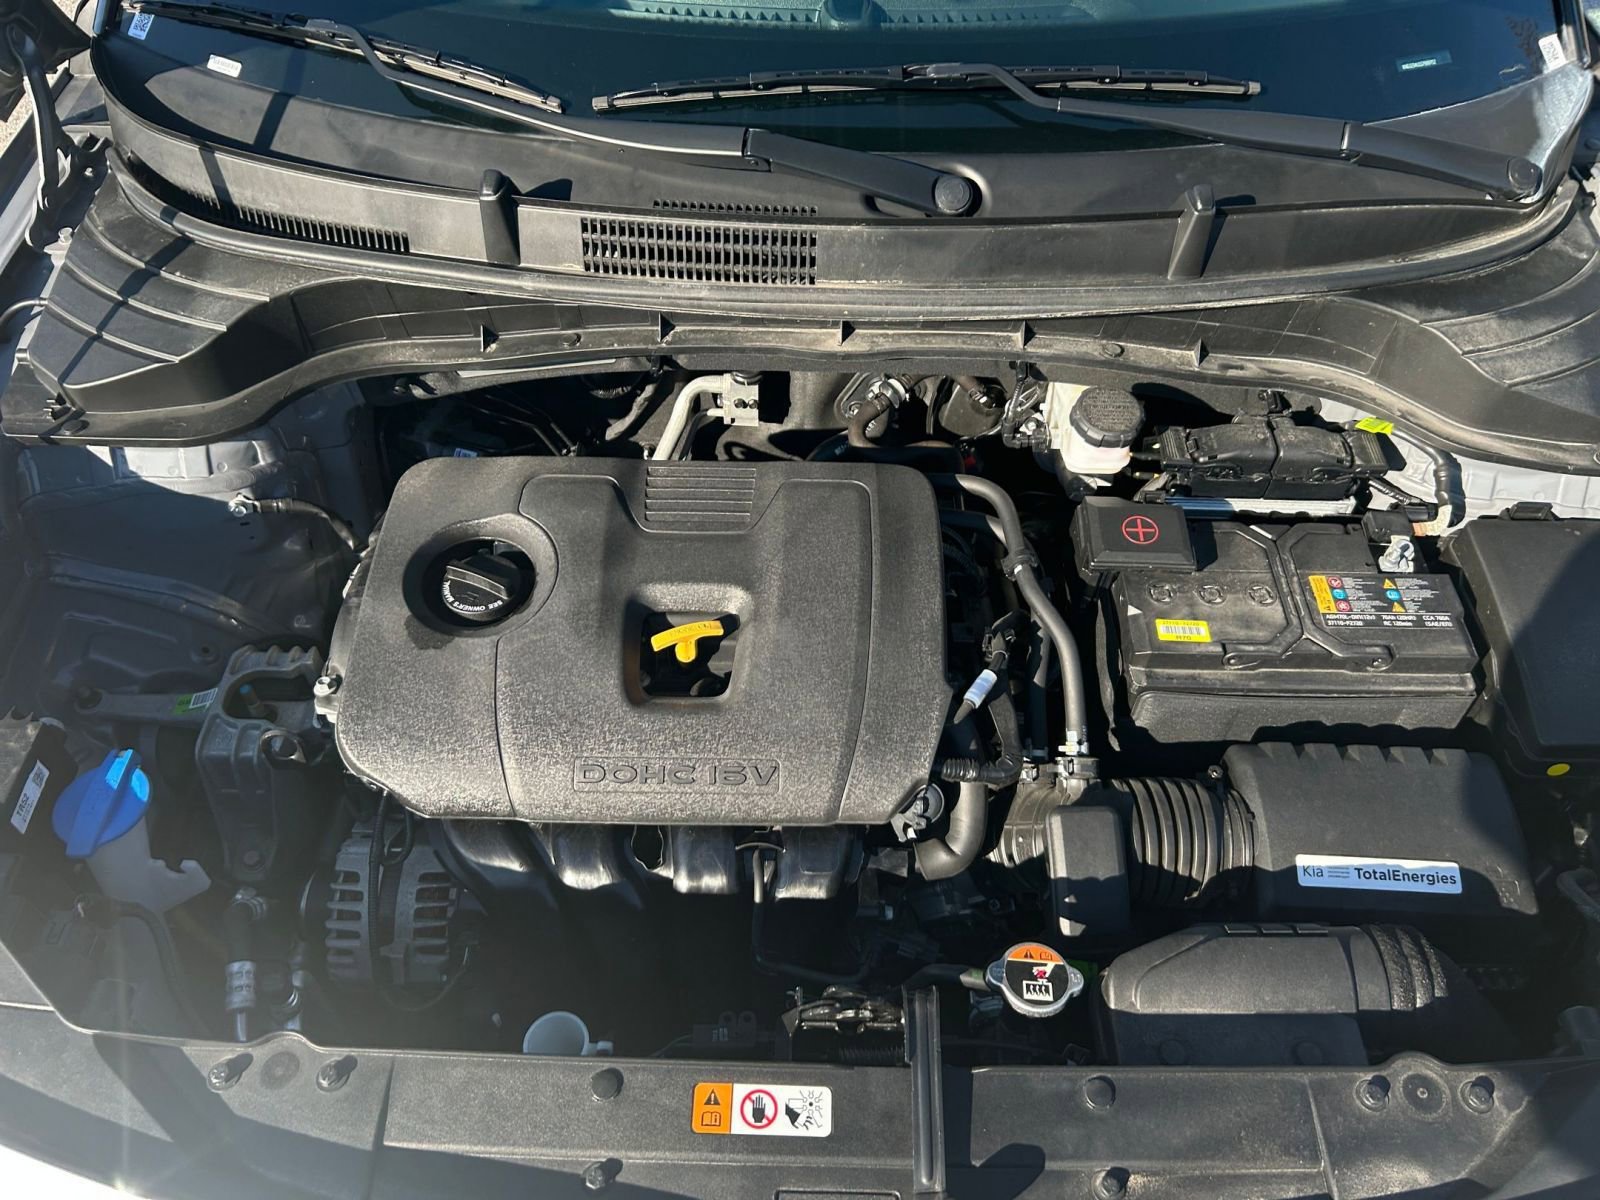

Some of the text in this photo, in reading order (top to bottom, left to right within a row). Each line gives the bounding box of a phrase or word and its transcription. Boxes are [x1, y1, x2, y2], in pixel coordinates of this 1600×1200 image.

[452, 600, 486, 612] OWNER'S
[488, 599, 503, 610] SEE
[576, 763, 778, 786] DOHC 16V
[1302, 865, 1457, 886] Kia TotalEnergies
